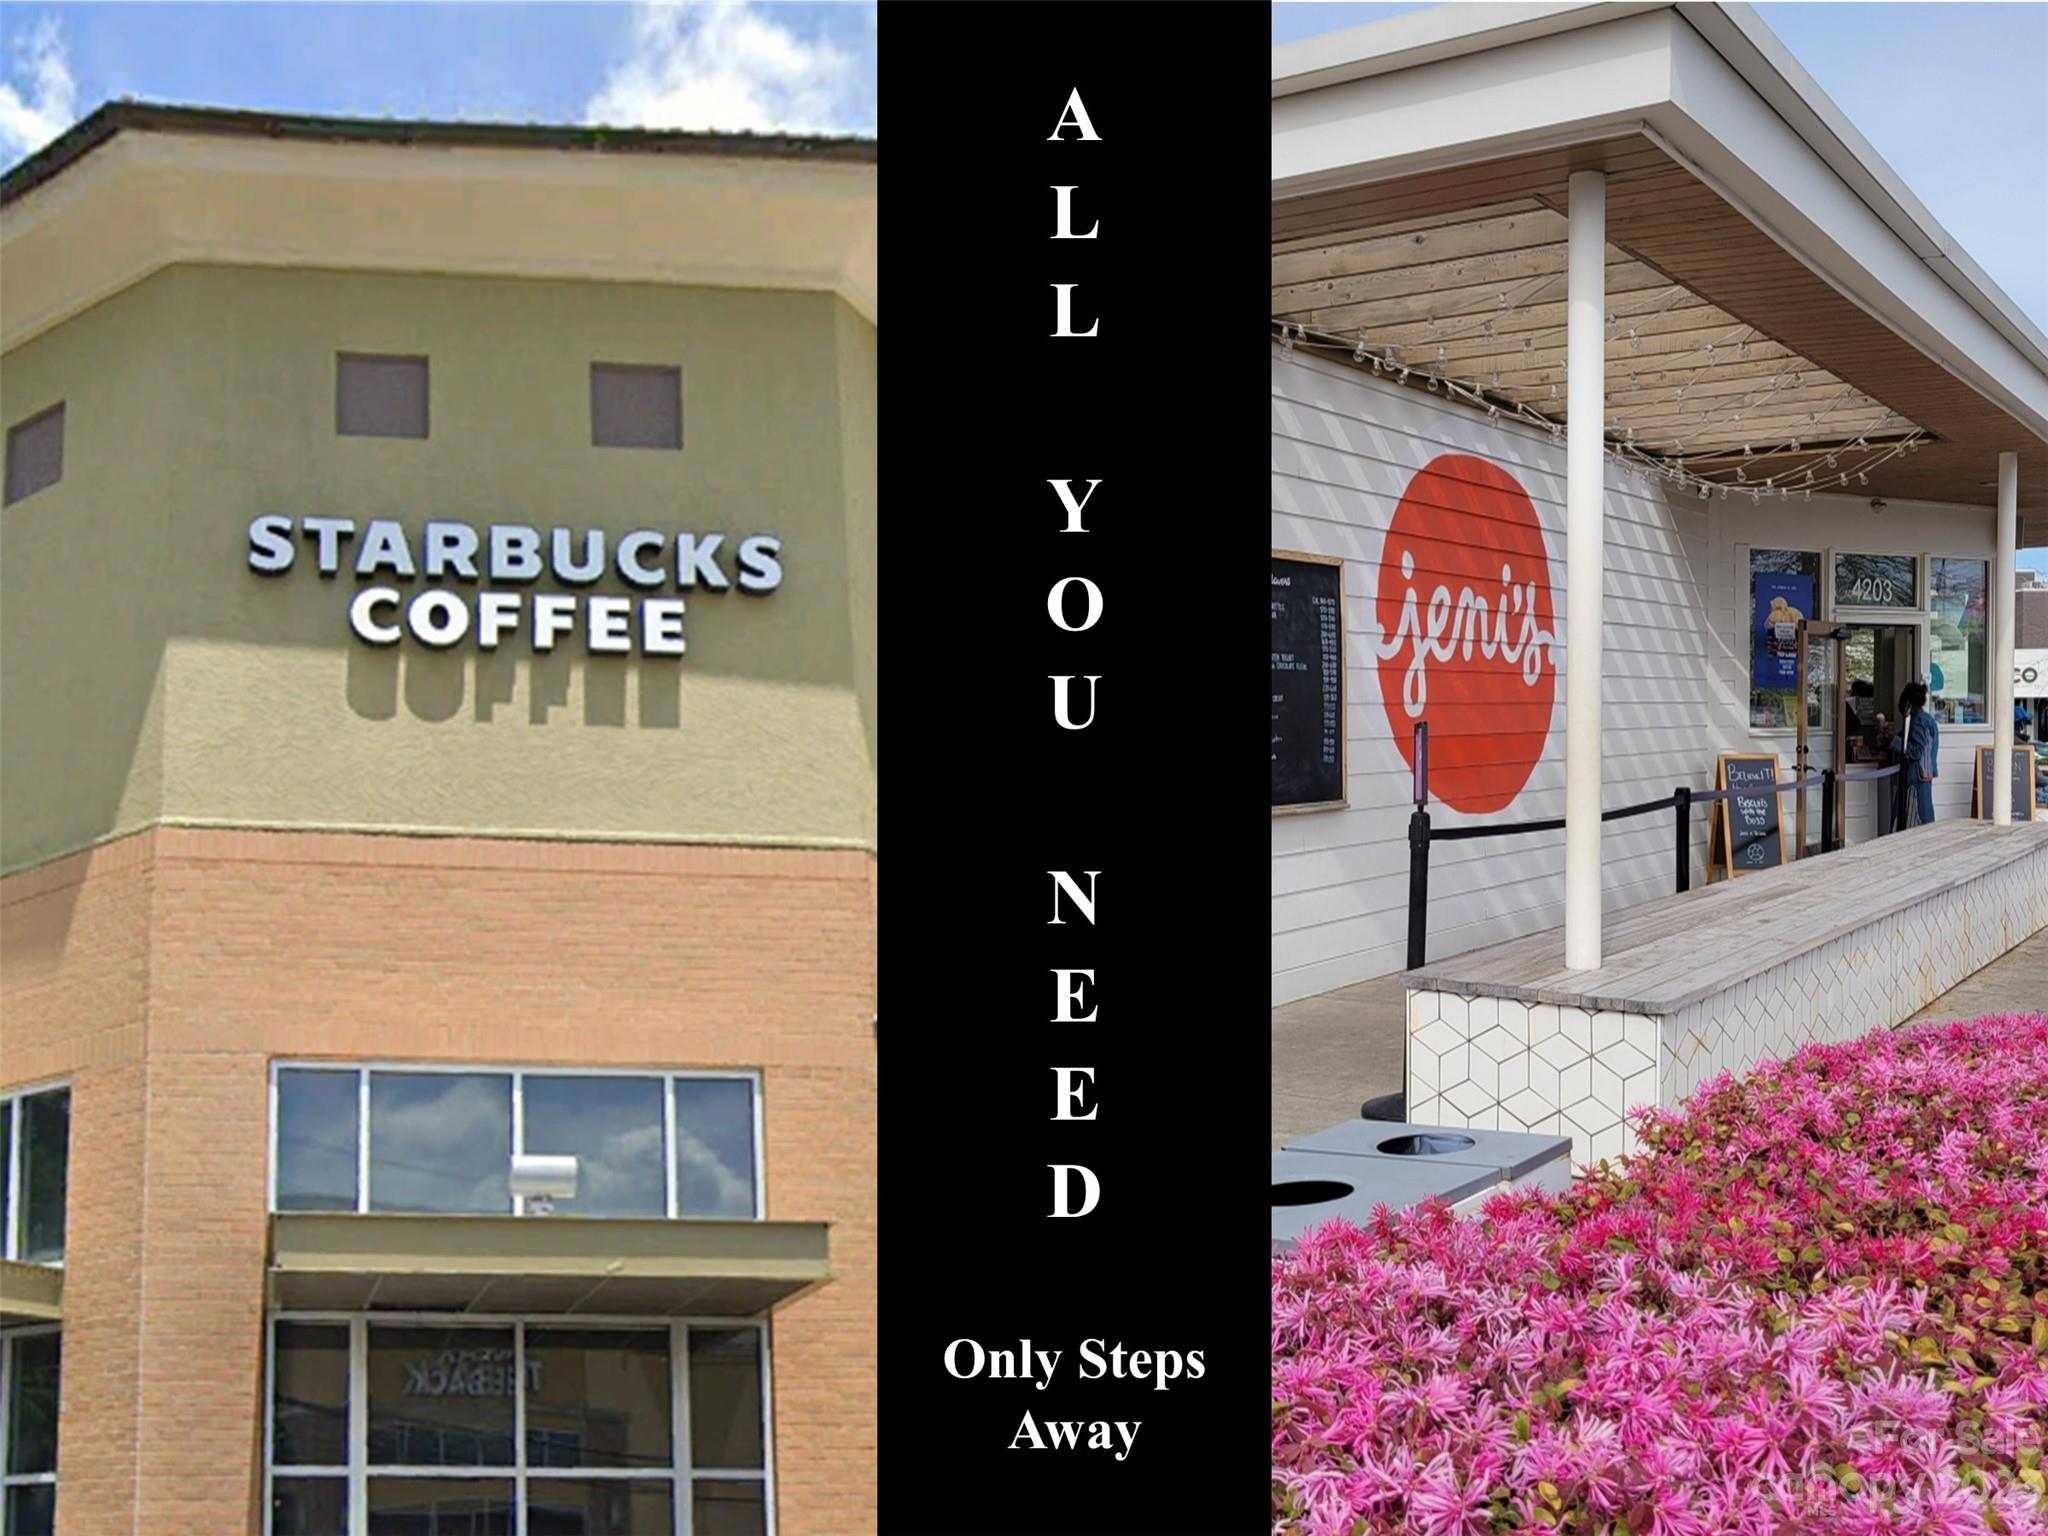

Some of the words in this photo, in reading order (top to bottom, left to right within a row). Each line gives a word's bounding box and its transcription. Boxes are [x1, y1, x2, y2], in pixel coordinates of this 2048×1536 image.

[247, 514, 784, 593] STARBUCKS
[1852, 577, 1893, 603] 4203
[348, 586, 687, 658] COFFEE
[1376, 550, 1557, 718] jeni's
